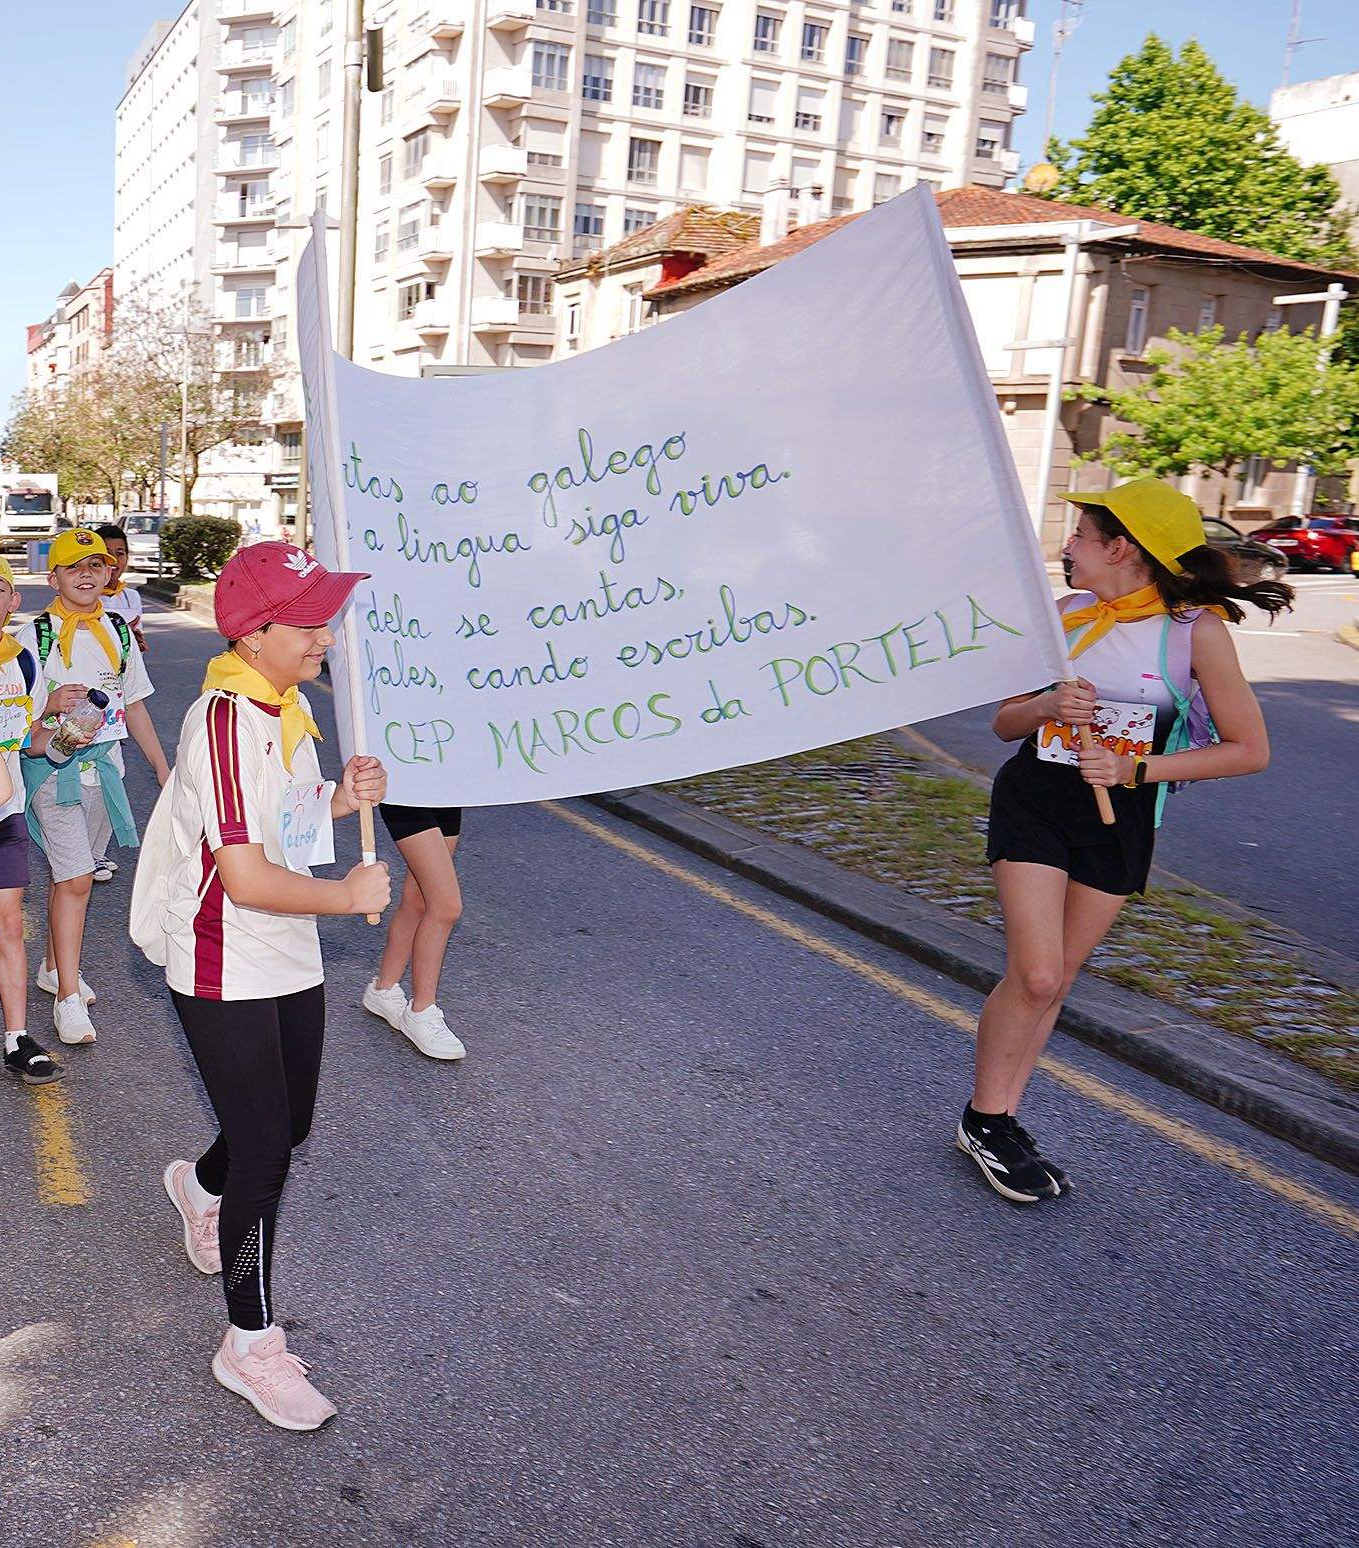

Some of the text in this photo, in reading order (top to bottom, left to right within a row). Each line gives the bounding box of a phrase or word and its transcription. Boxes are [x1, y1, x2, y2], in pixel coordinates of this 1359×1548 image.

[364, 529, 385, 551] a
[397, 512, 532, 588] lingua
[564, 506, 650, 564] siga
[669, 463, 793, 517] viva.
[431, 480, 479, 505] ao
[527, 427, 686, 529] galego
[365, 584, 817, 715] fales, cando escribas.
[367, 570, 685, 639] dela se cantas,
[385, 593, 1027, 775] CEP MARCOS da PORTELA
